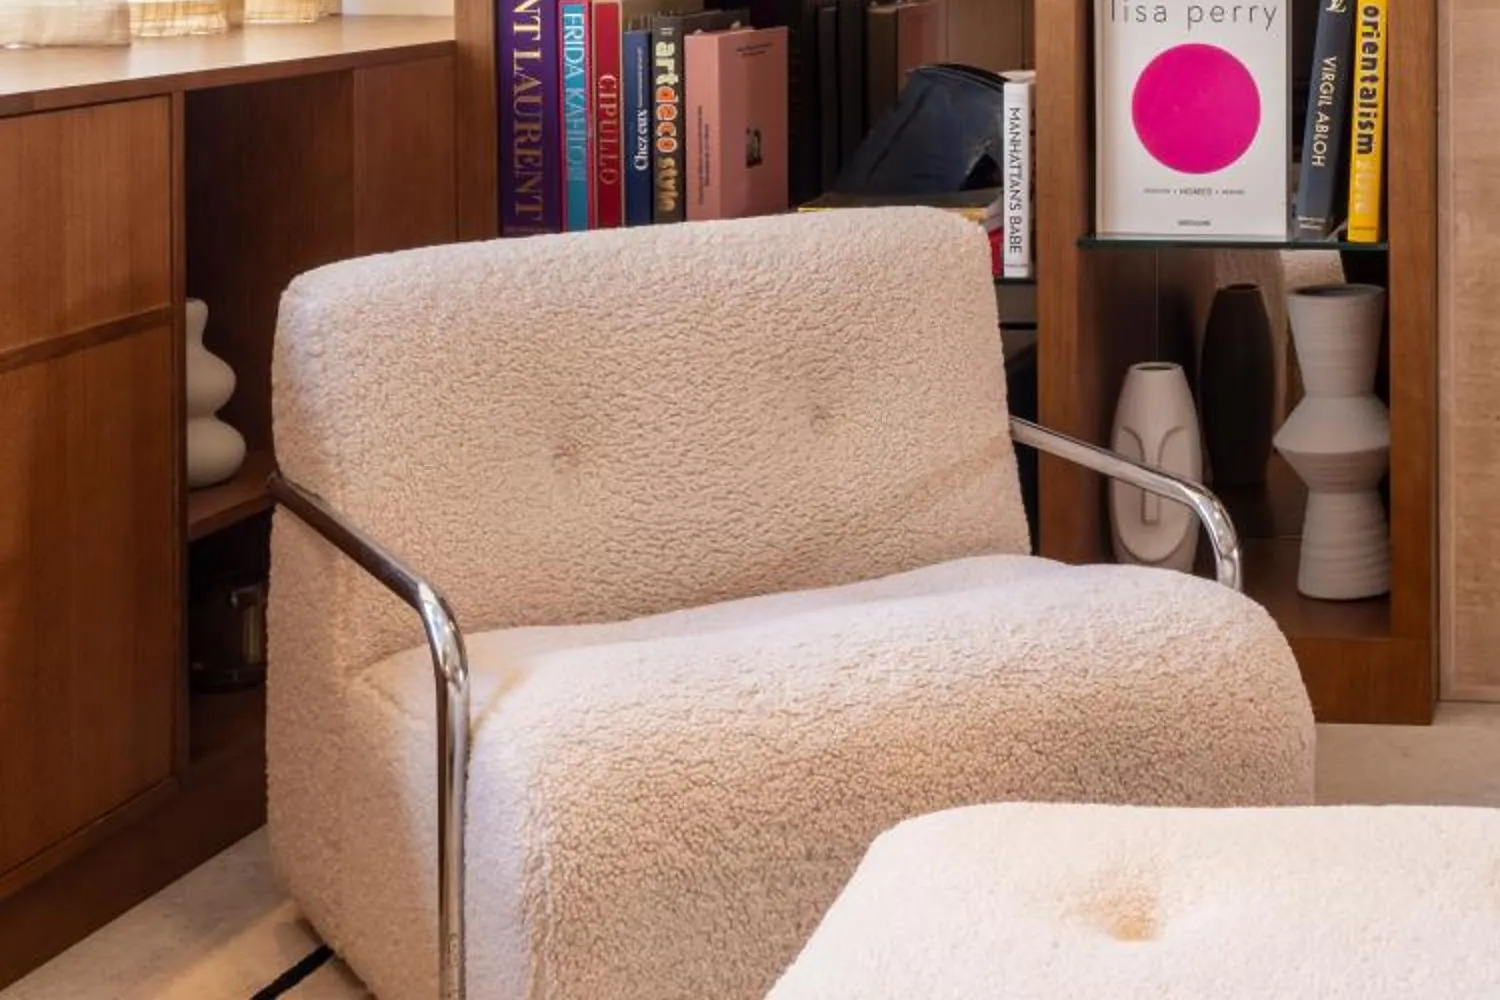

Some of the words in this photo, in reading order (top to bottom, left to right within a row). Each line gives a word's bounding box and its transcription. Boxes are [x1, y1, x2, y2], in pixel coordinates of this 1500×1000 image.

[563, 12, 585, 80] FRIDA
[1187, 2, 1279, 31] perry
[1318, 55, 1338, 111] VIRGIL
[1356, 4, 1381, 156] orientalism
[512, 48, 543, 222] LAURENT
[564, 86, 587, 160] KAHLO
[598, 73, 620, 185] CIPULLO
[634, 108, 649, 135] eux
[1311, 111, 1332, 168] ABLOH
[633, 136, 649, 171] Chez
[1008, 107, 1023, 211] MANHATTAN'S
[1009, 216, 1023, 253] BABE
